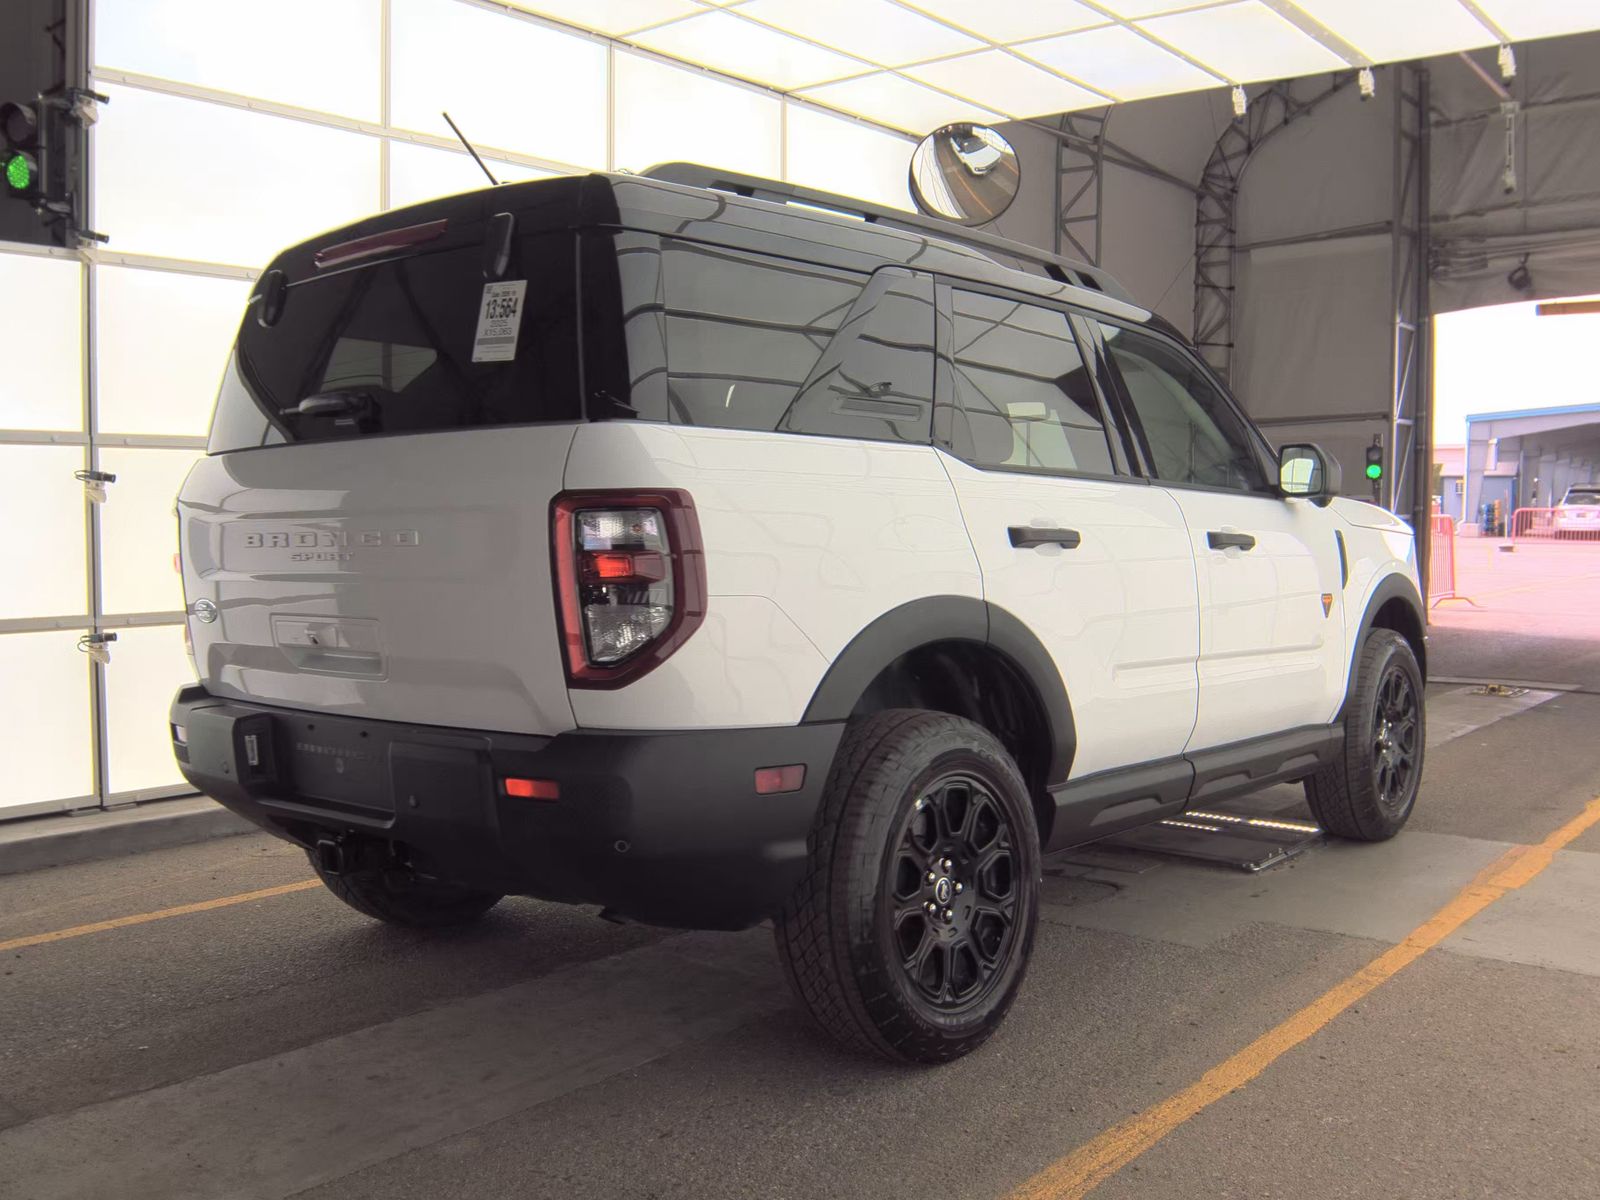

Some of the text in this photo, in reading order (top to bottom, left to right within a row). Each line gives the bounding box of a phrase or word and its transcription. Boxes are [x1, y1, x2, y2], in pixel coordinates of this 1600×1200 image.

[486, 297, 518, 319] 13:564
[243, 529, 422, 549] BRONCO
[290, 550, 354, 562] SPORT
